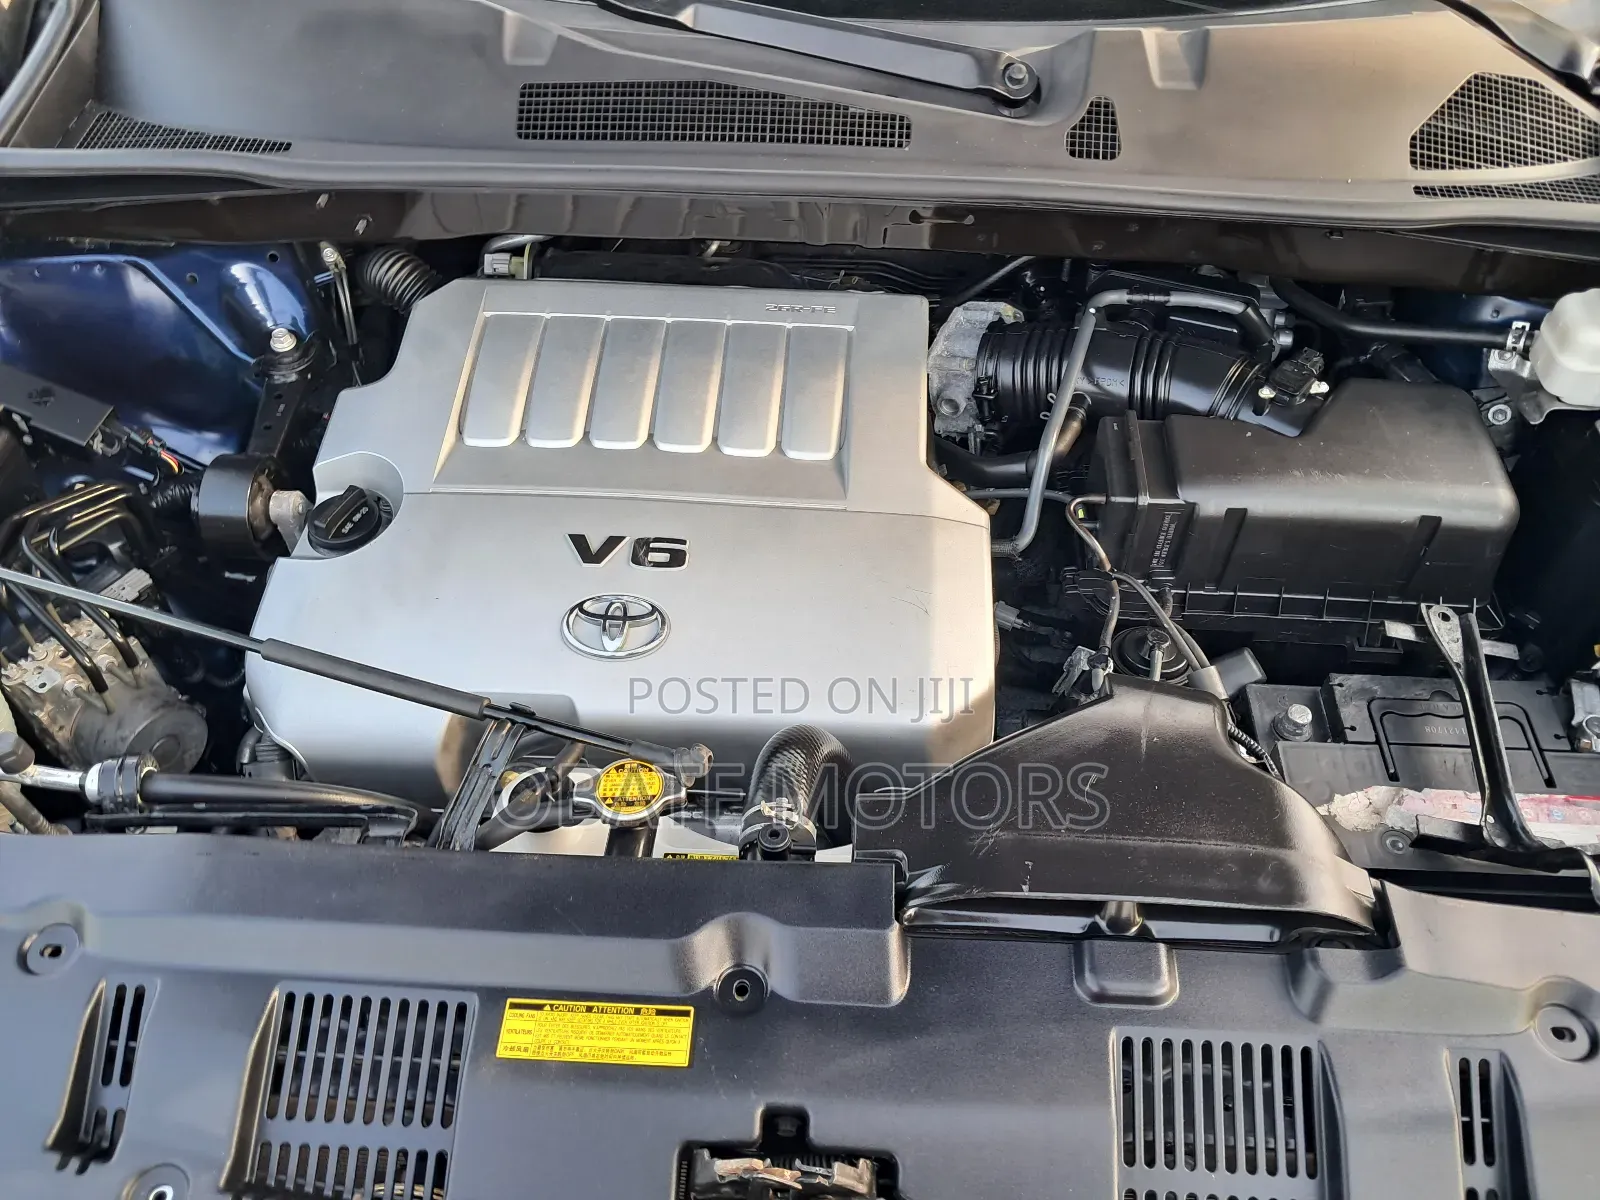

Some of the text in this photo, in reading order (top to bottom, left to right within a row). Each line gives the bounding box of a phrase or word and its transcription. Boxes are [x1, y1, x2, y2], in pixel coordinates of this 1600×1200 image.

[765, 303, 836, 314] 2GR-FE
[565, 533, 690, 571] V6
[552, 1004, 587, 1013] CAUTION
[592, 1006, 635, 1015] ATTENTION
